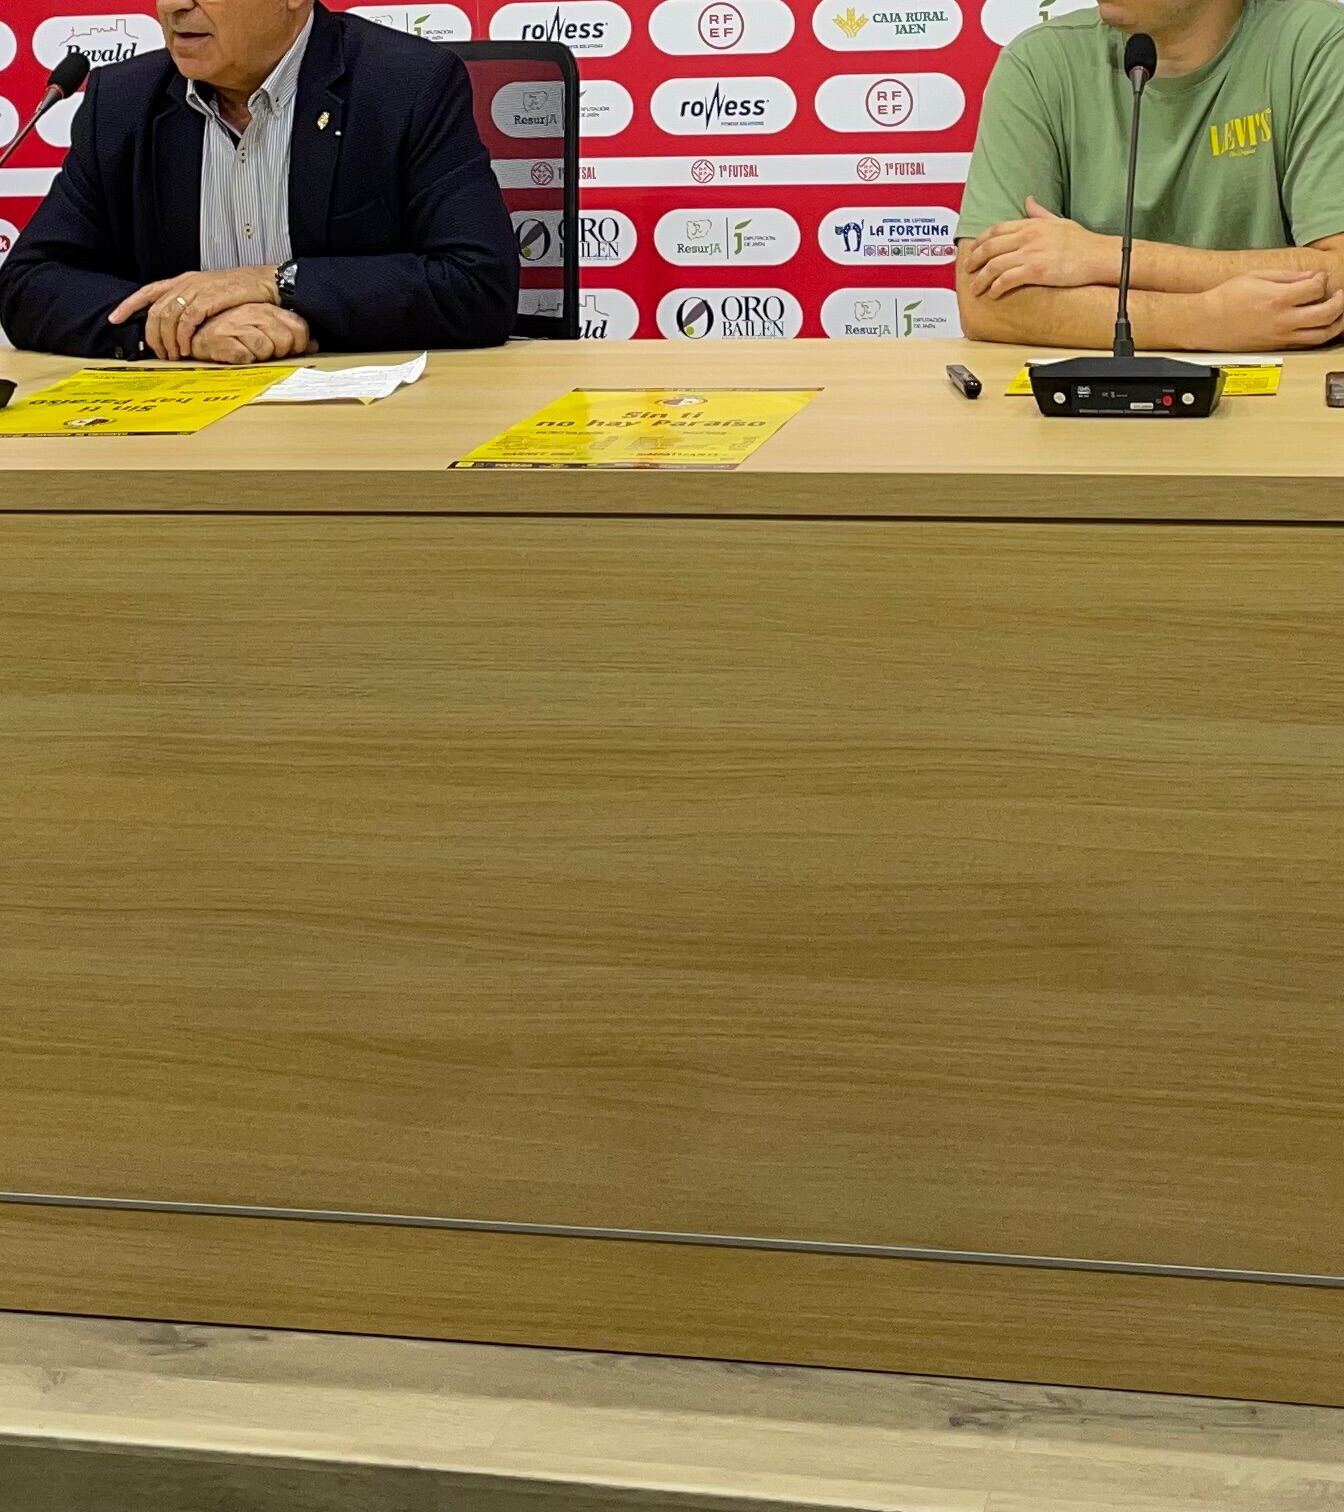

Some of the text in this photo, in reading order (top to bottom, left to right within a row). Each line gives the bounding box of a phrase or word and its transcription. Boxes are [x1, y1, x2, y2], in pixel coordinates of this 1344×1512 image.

[873, 11, 948, 24] CAJA RURAL
[894, 22, 926, 35] JAEN
[728, 163, 759, 177] FUTSAL
[895, 161, 926, 176] FUTSAL
[869, 223, 949, 236] LA FORTUNA
[722, 296, 785, 320] ORO
